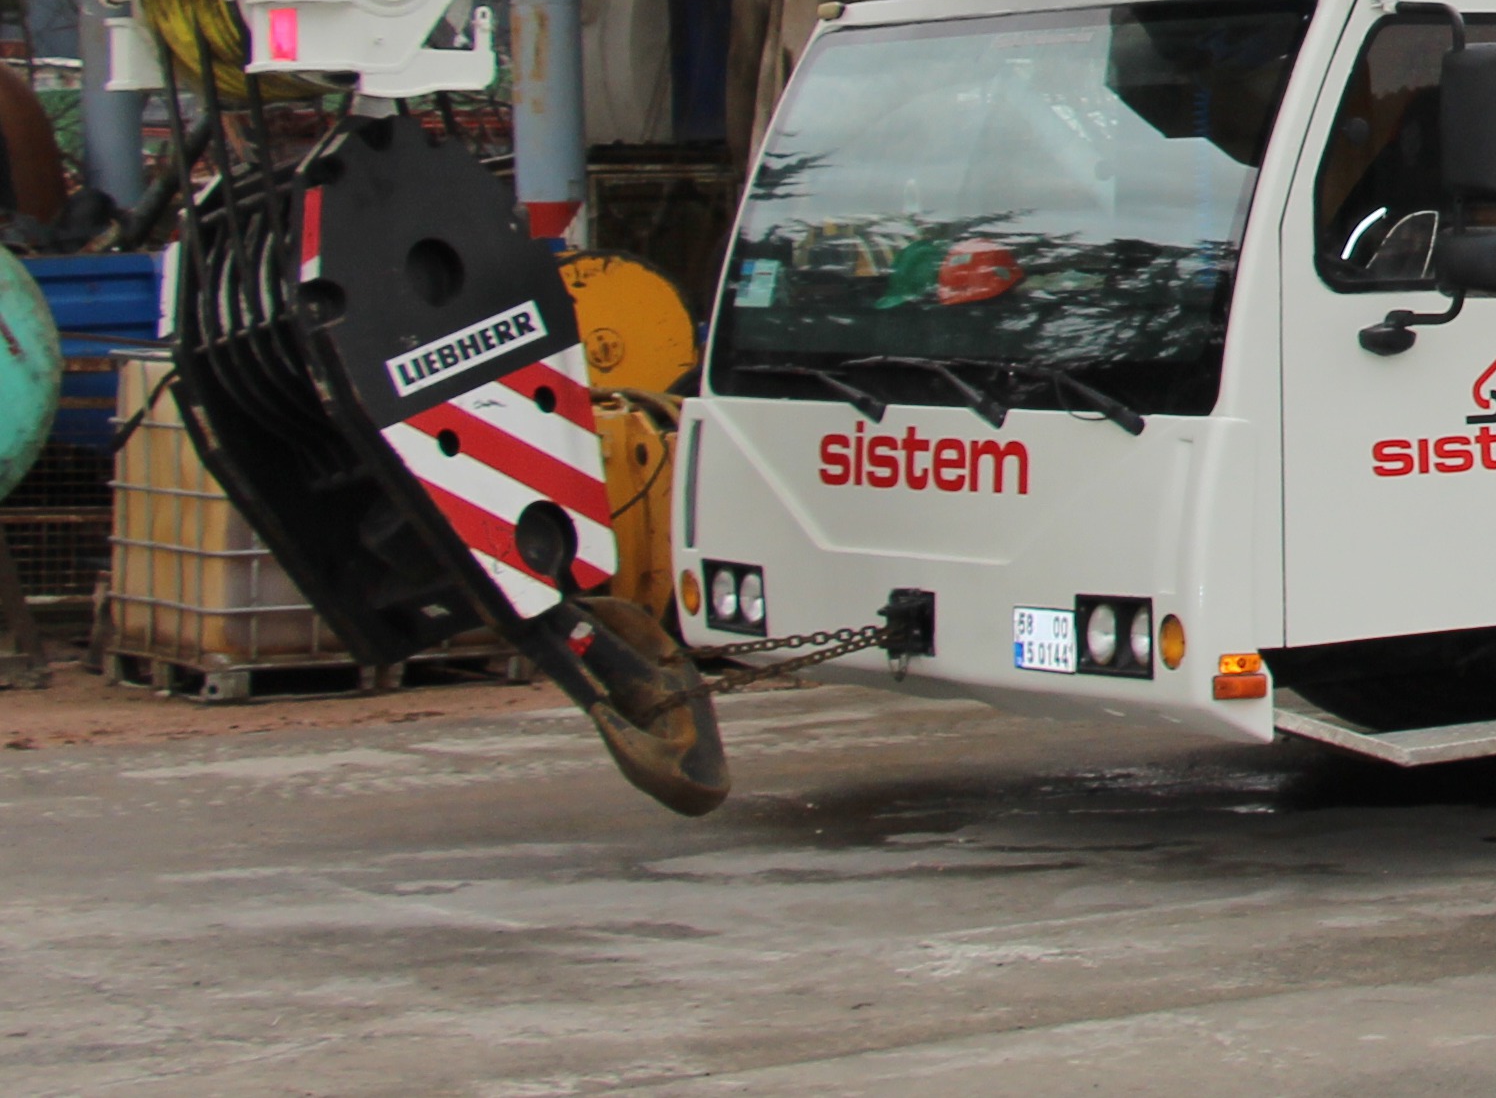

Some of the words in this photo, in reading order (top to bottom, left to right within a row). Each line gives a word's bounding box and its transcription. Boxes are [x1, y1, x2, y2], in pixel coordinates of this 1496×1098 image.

[397, 311, 537, 387] LIEBHERR
[818, 420, 1029, 495] sistem
[1018, 612, 1034, 635] 58
[1053, 615, 1069, 639] 00
